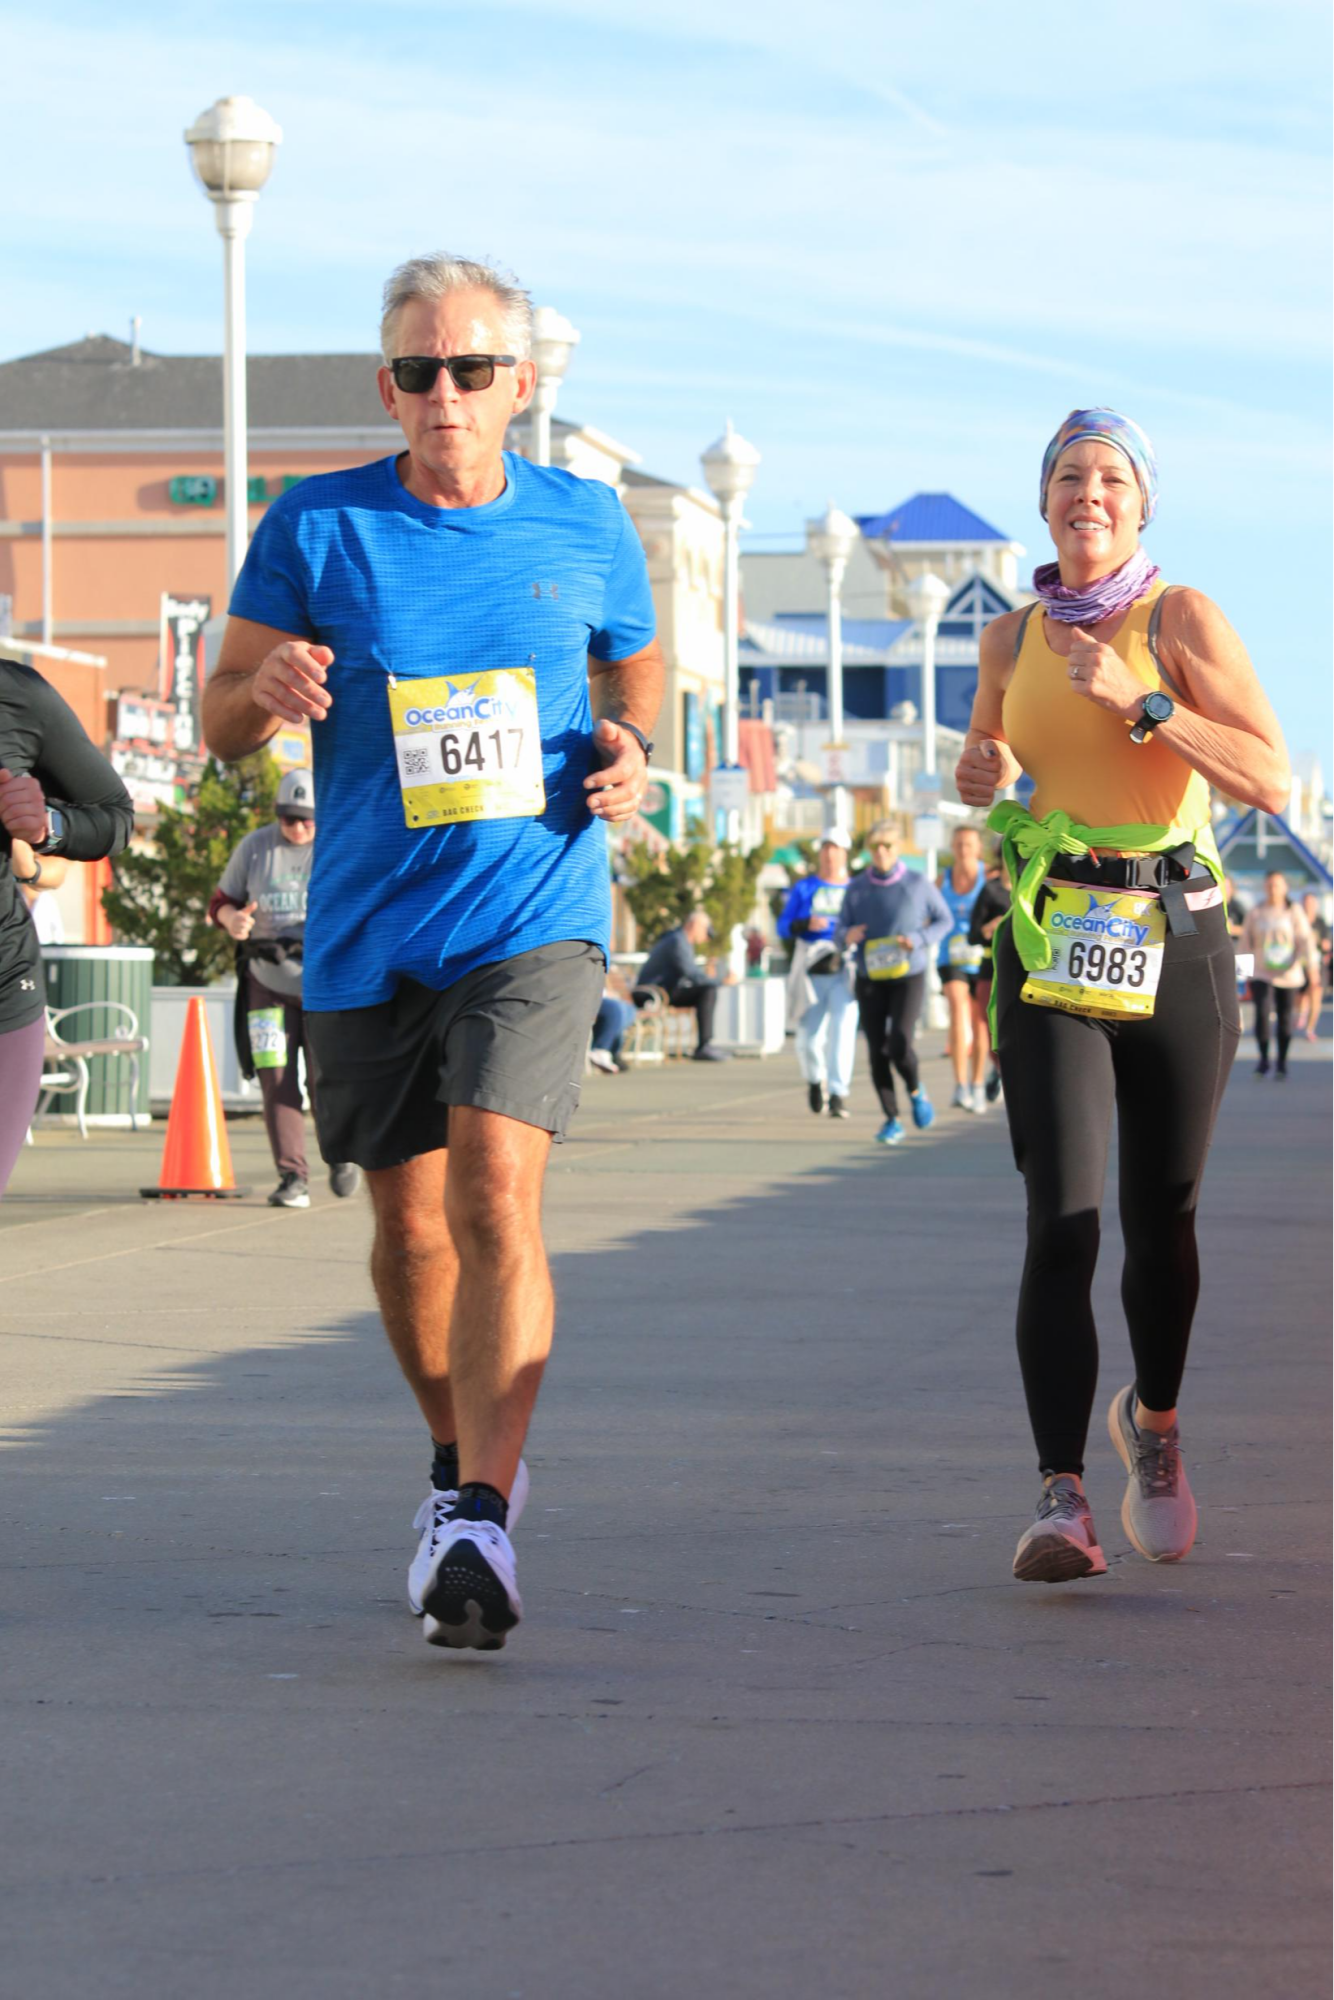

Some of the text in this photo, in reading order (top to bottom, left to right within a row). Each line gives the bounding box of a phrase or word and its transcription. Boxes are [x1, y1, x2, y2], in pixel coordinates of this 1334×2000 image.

[440, 728, 525, 775] 6417
[1134, 902, 1152, 916] 8K
[1068, 941, 1147, 988] 6983
